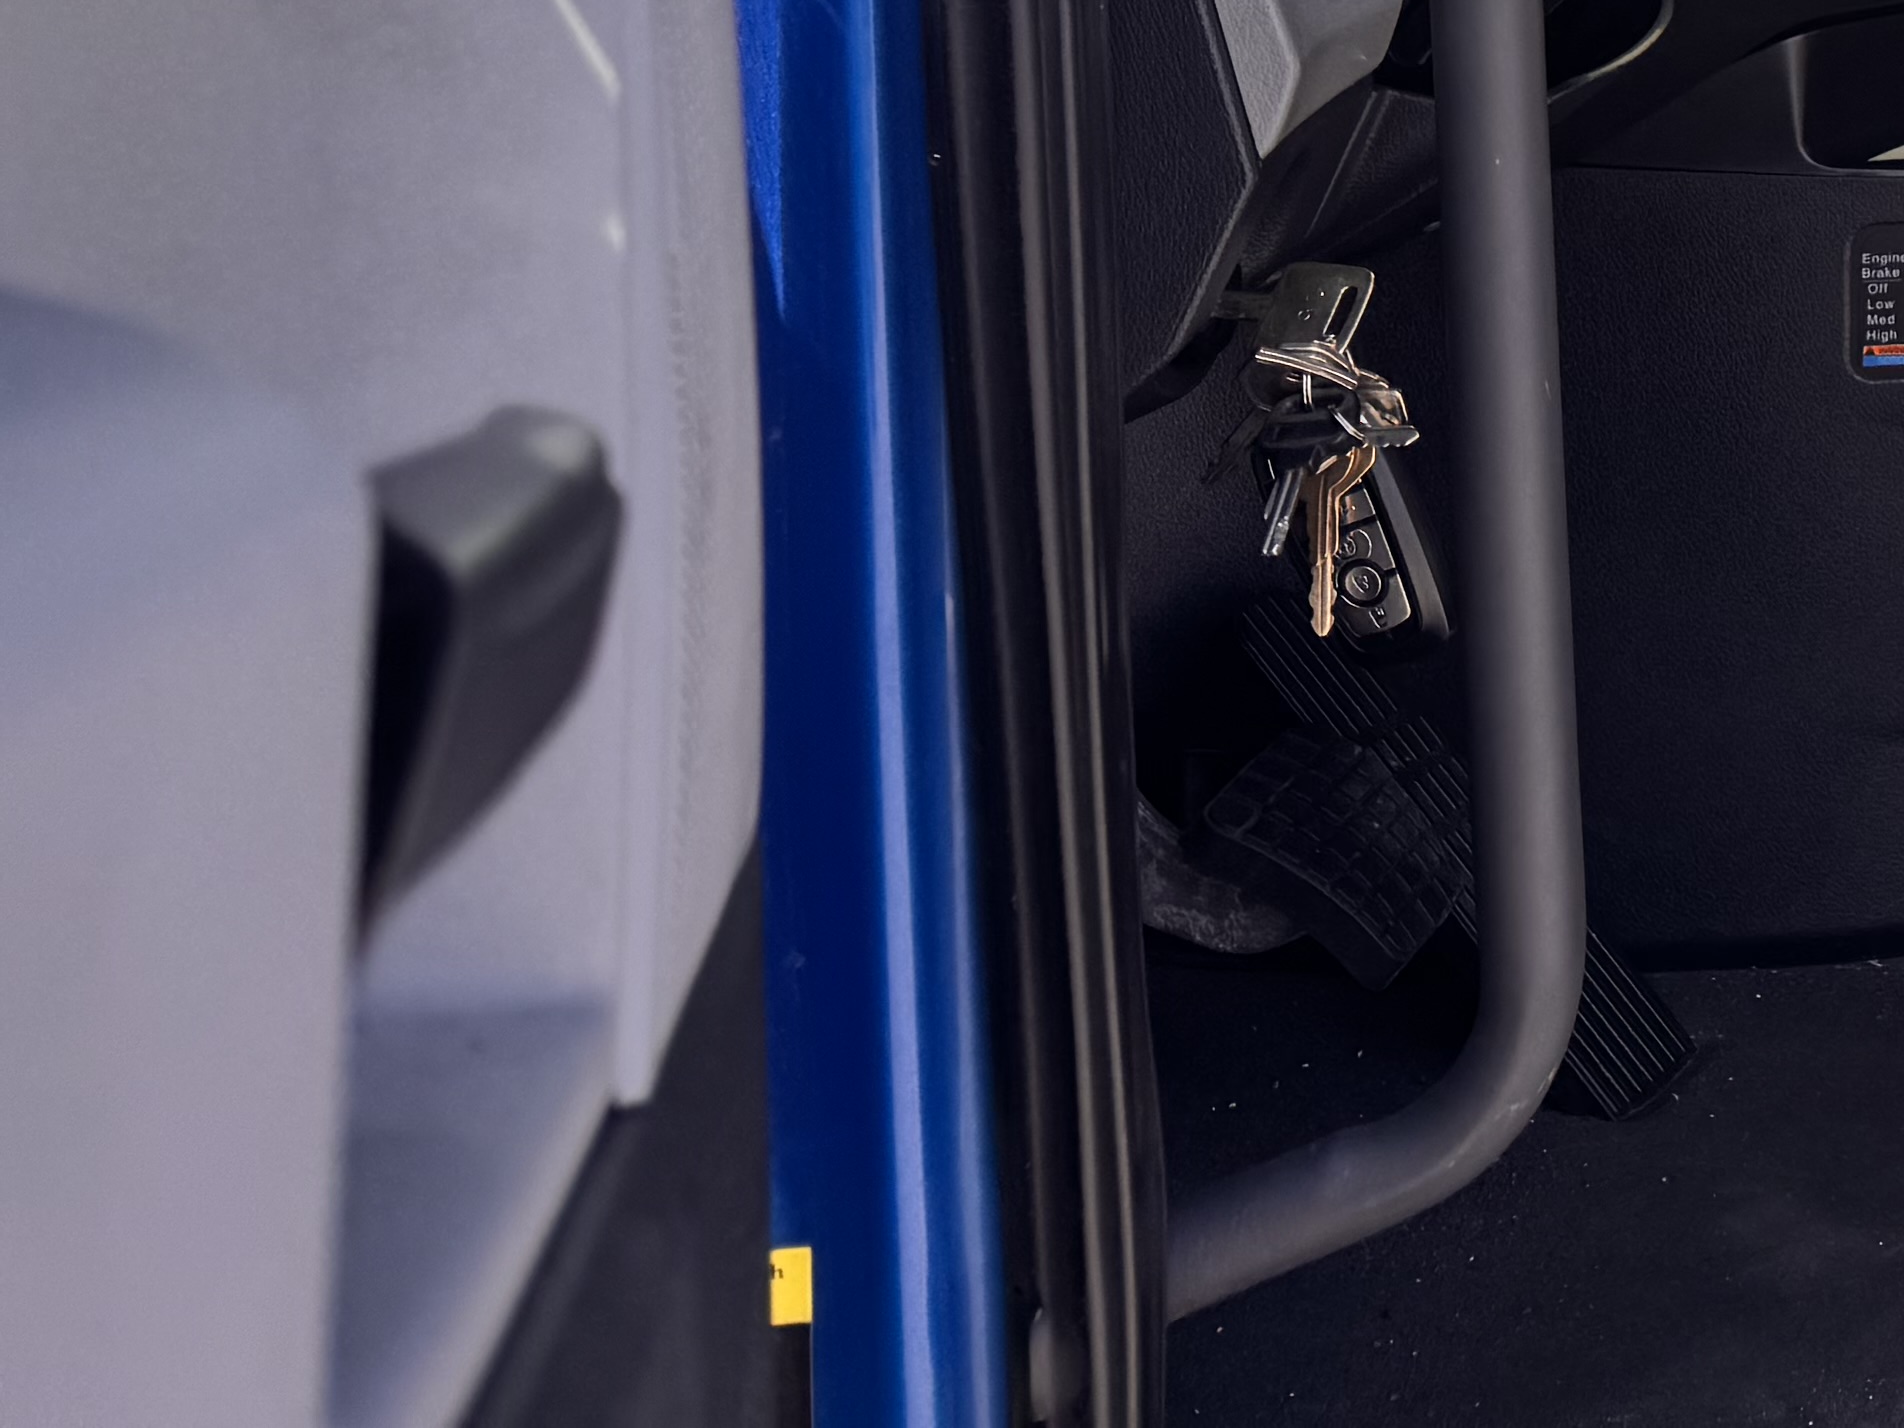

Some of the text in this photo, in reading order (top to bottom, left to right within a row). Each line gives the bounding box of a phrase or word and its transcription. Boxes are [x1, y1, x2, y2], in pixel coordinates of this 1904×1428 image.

[1862, 268, 1900, 279] Brake
[1868, 283, 1889, 294] Off
[1867, 299, 1895, 310] Low
[1867, 314, 1895, 325] Med
[1866, 329, 1897, 342] High
